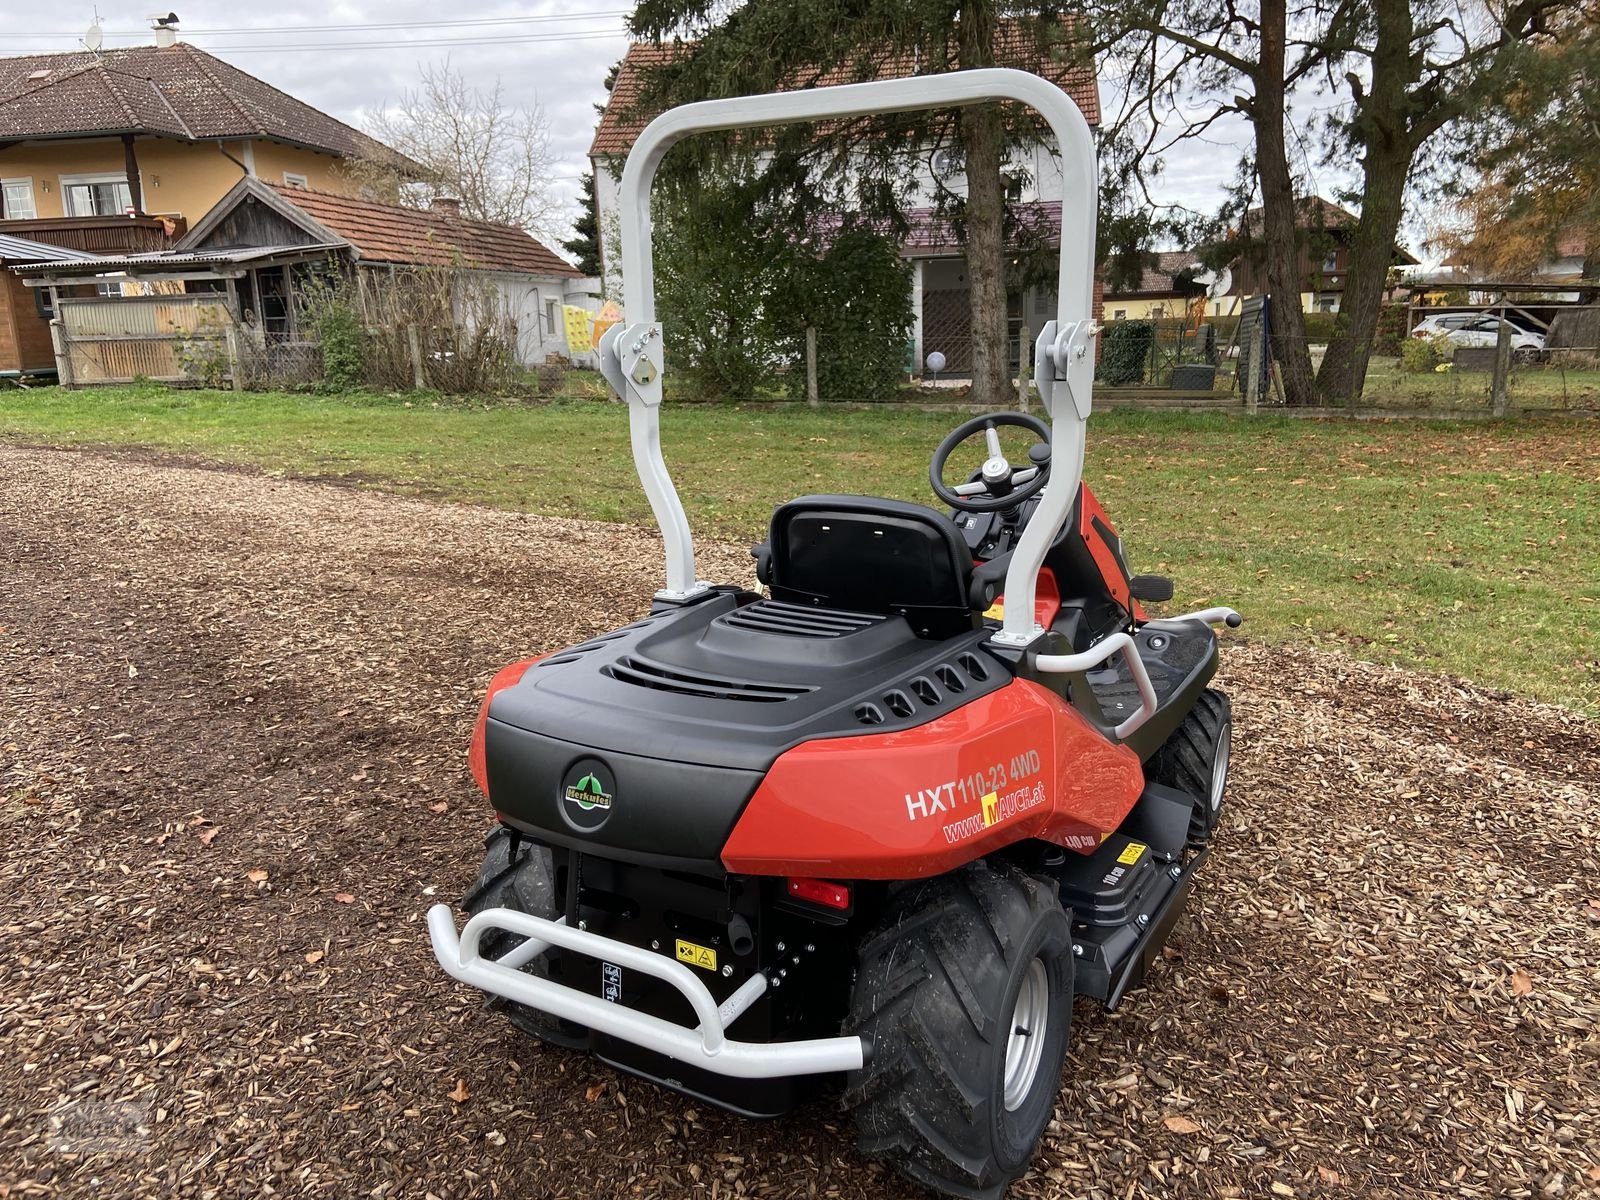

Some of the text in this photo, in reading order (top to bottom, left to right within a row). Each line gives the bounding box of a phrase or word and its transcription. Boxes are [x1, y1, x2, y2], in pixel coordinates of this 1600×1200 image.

[1010, 749, 1041, 781] 4WD
[567, 788, 609, 806] Herkules
[1102, 874, 1119, 886] 110
